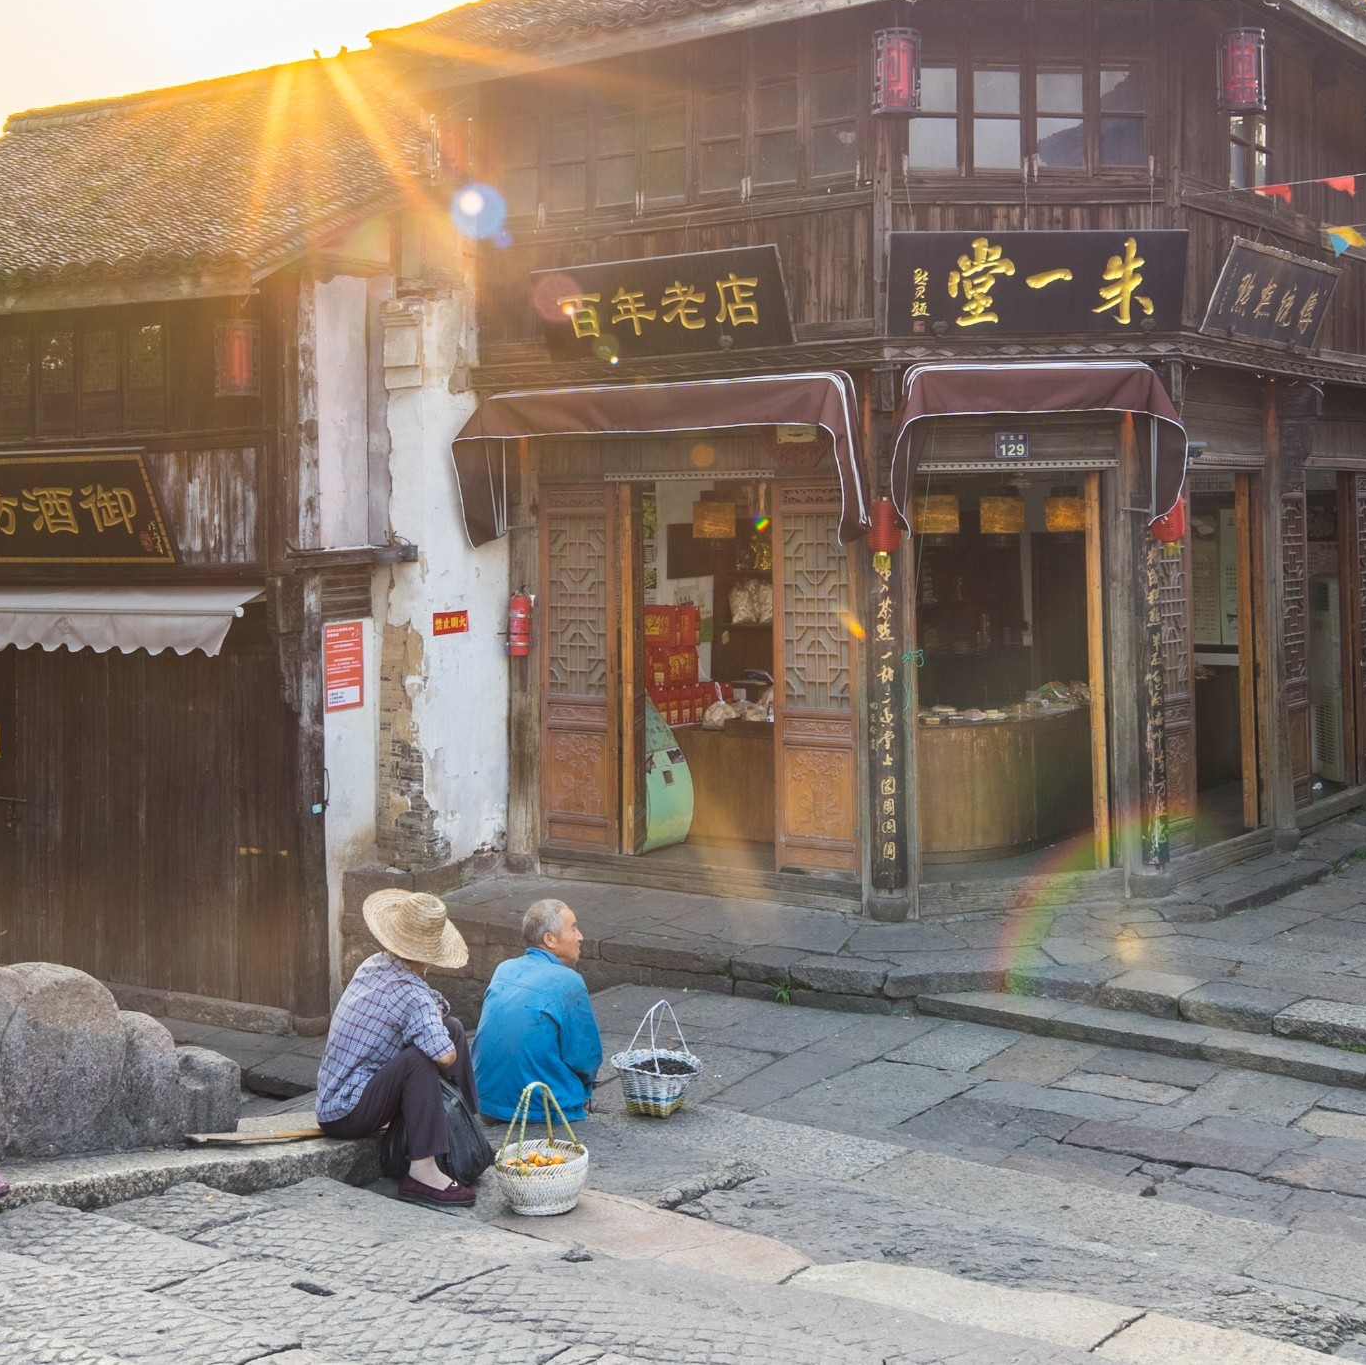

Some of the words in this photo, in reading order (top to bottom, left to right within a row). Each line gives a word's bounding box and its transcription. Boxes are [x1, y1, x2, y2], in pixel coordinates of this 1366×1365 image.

[556, 272, 760, 340] 百年老店
[999, 443, 1025, 456] 129
[434, 614, 467, 632] 禁止明火
